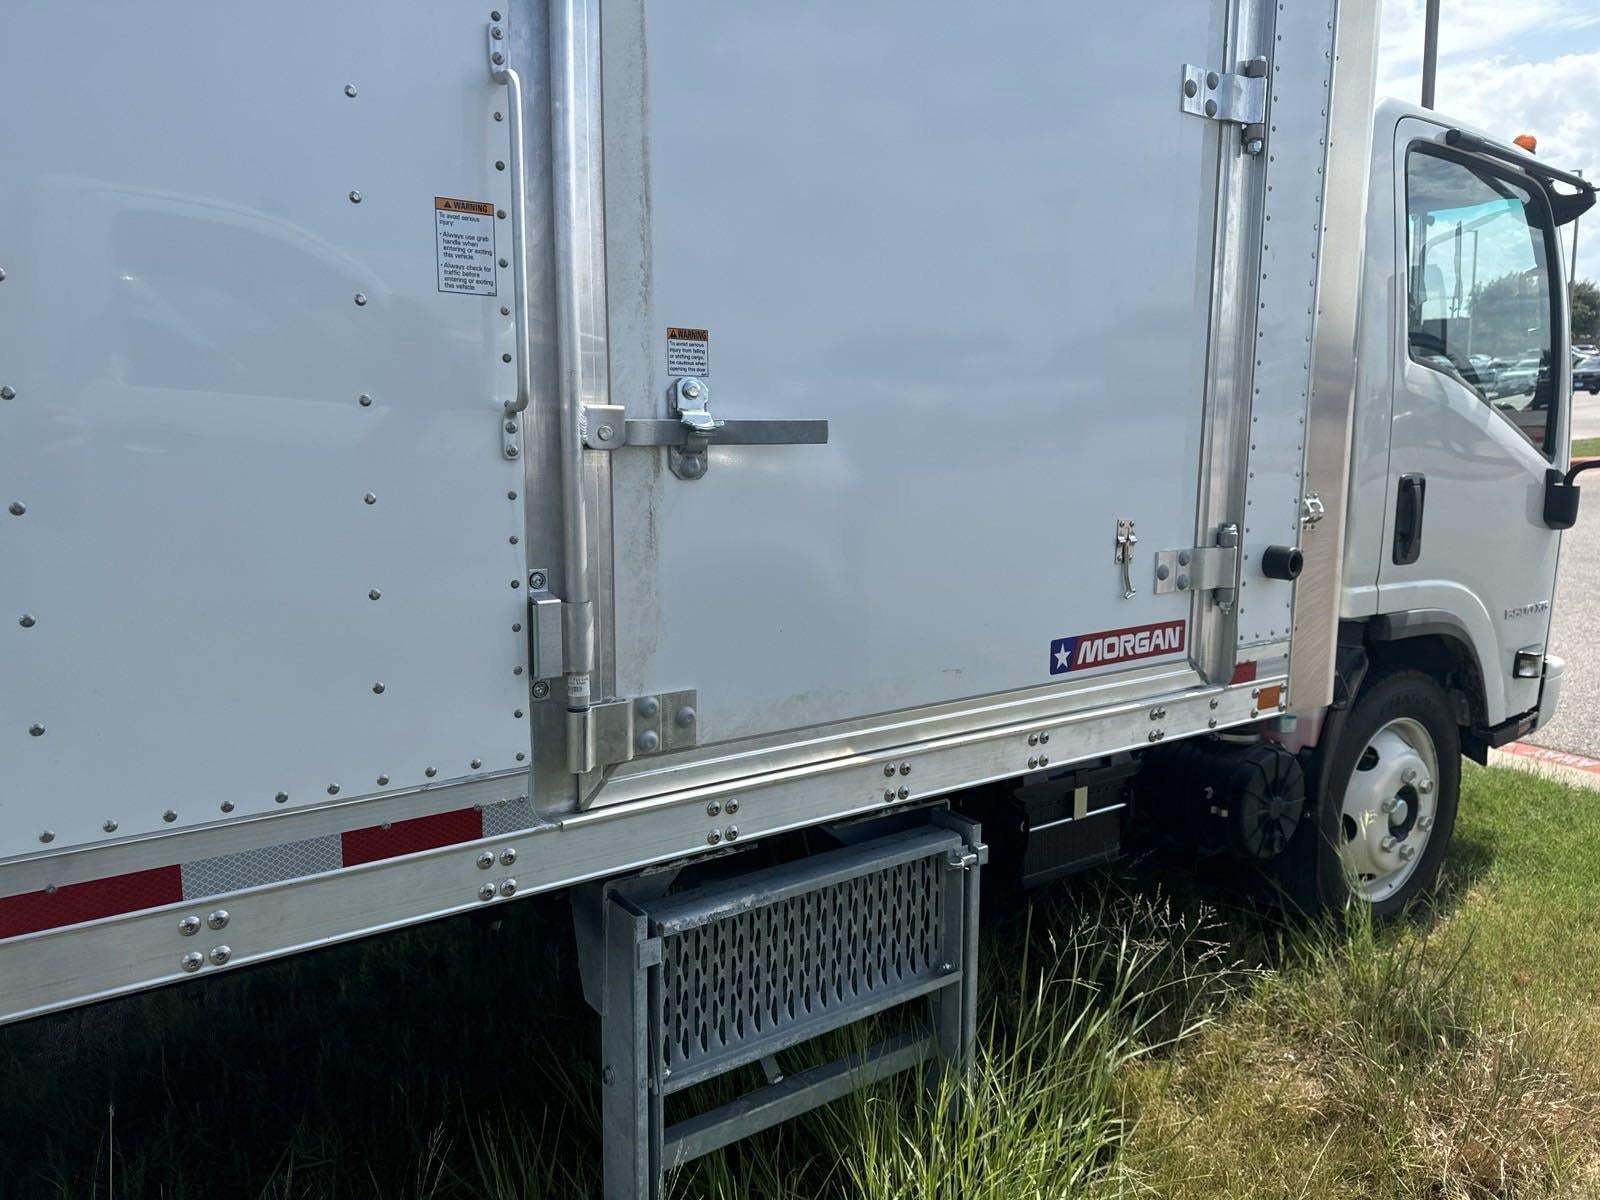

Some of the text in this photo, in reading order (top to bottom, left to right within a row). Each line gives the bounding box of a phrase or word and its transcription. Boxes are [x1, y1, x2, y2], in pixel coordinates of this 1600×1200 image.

[454, 202, 488, 213] WARNING
[443, 232, 464, 240] Always
[475, 248, 492, 256] exiting
[443, 262, 465, 270] Always
[444, 276, 467, 284] entering
[678, 329, 706, 339] WARNING
[1077, 626, 1180, 664] MORGAN
